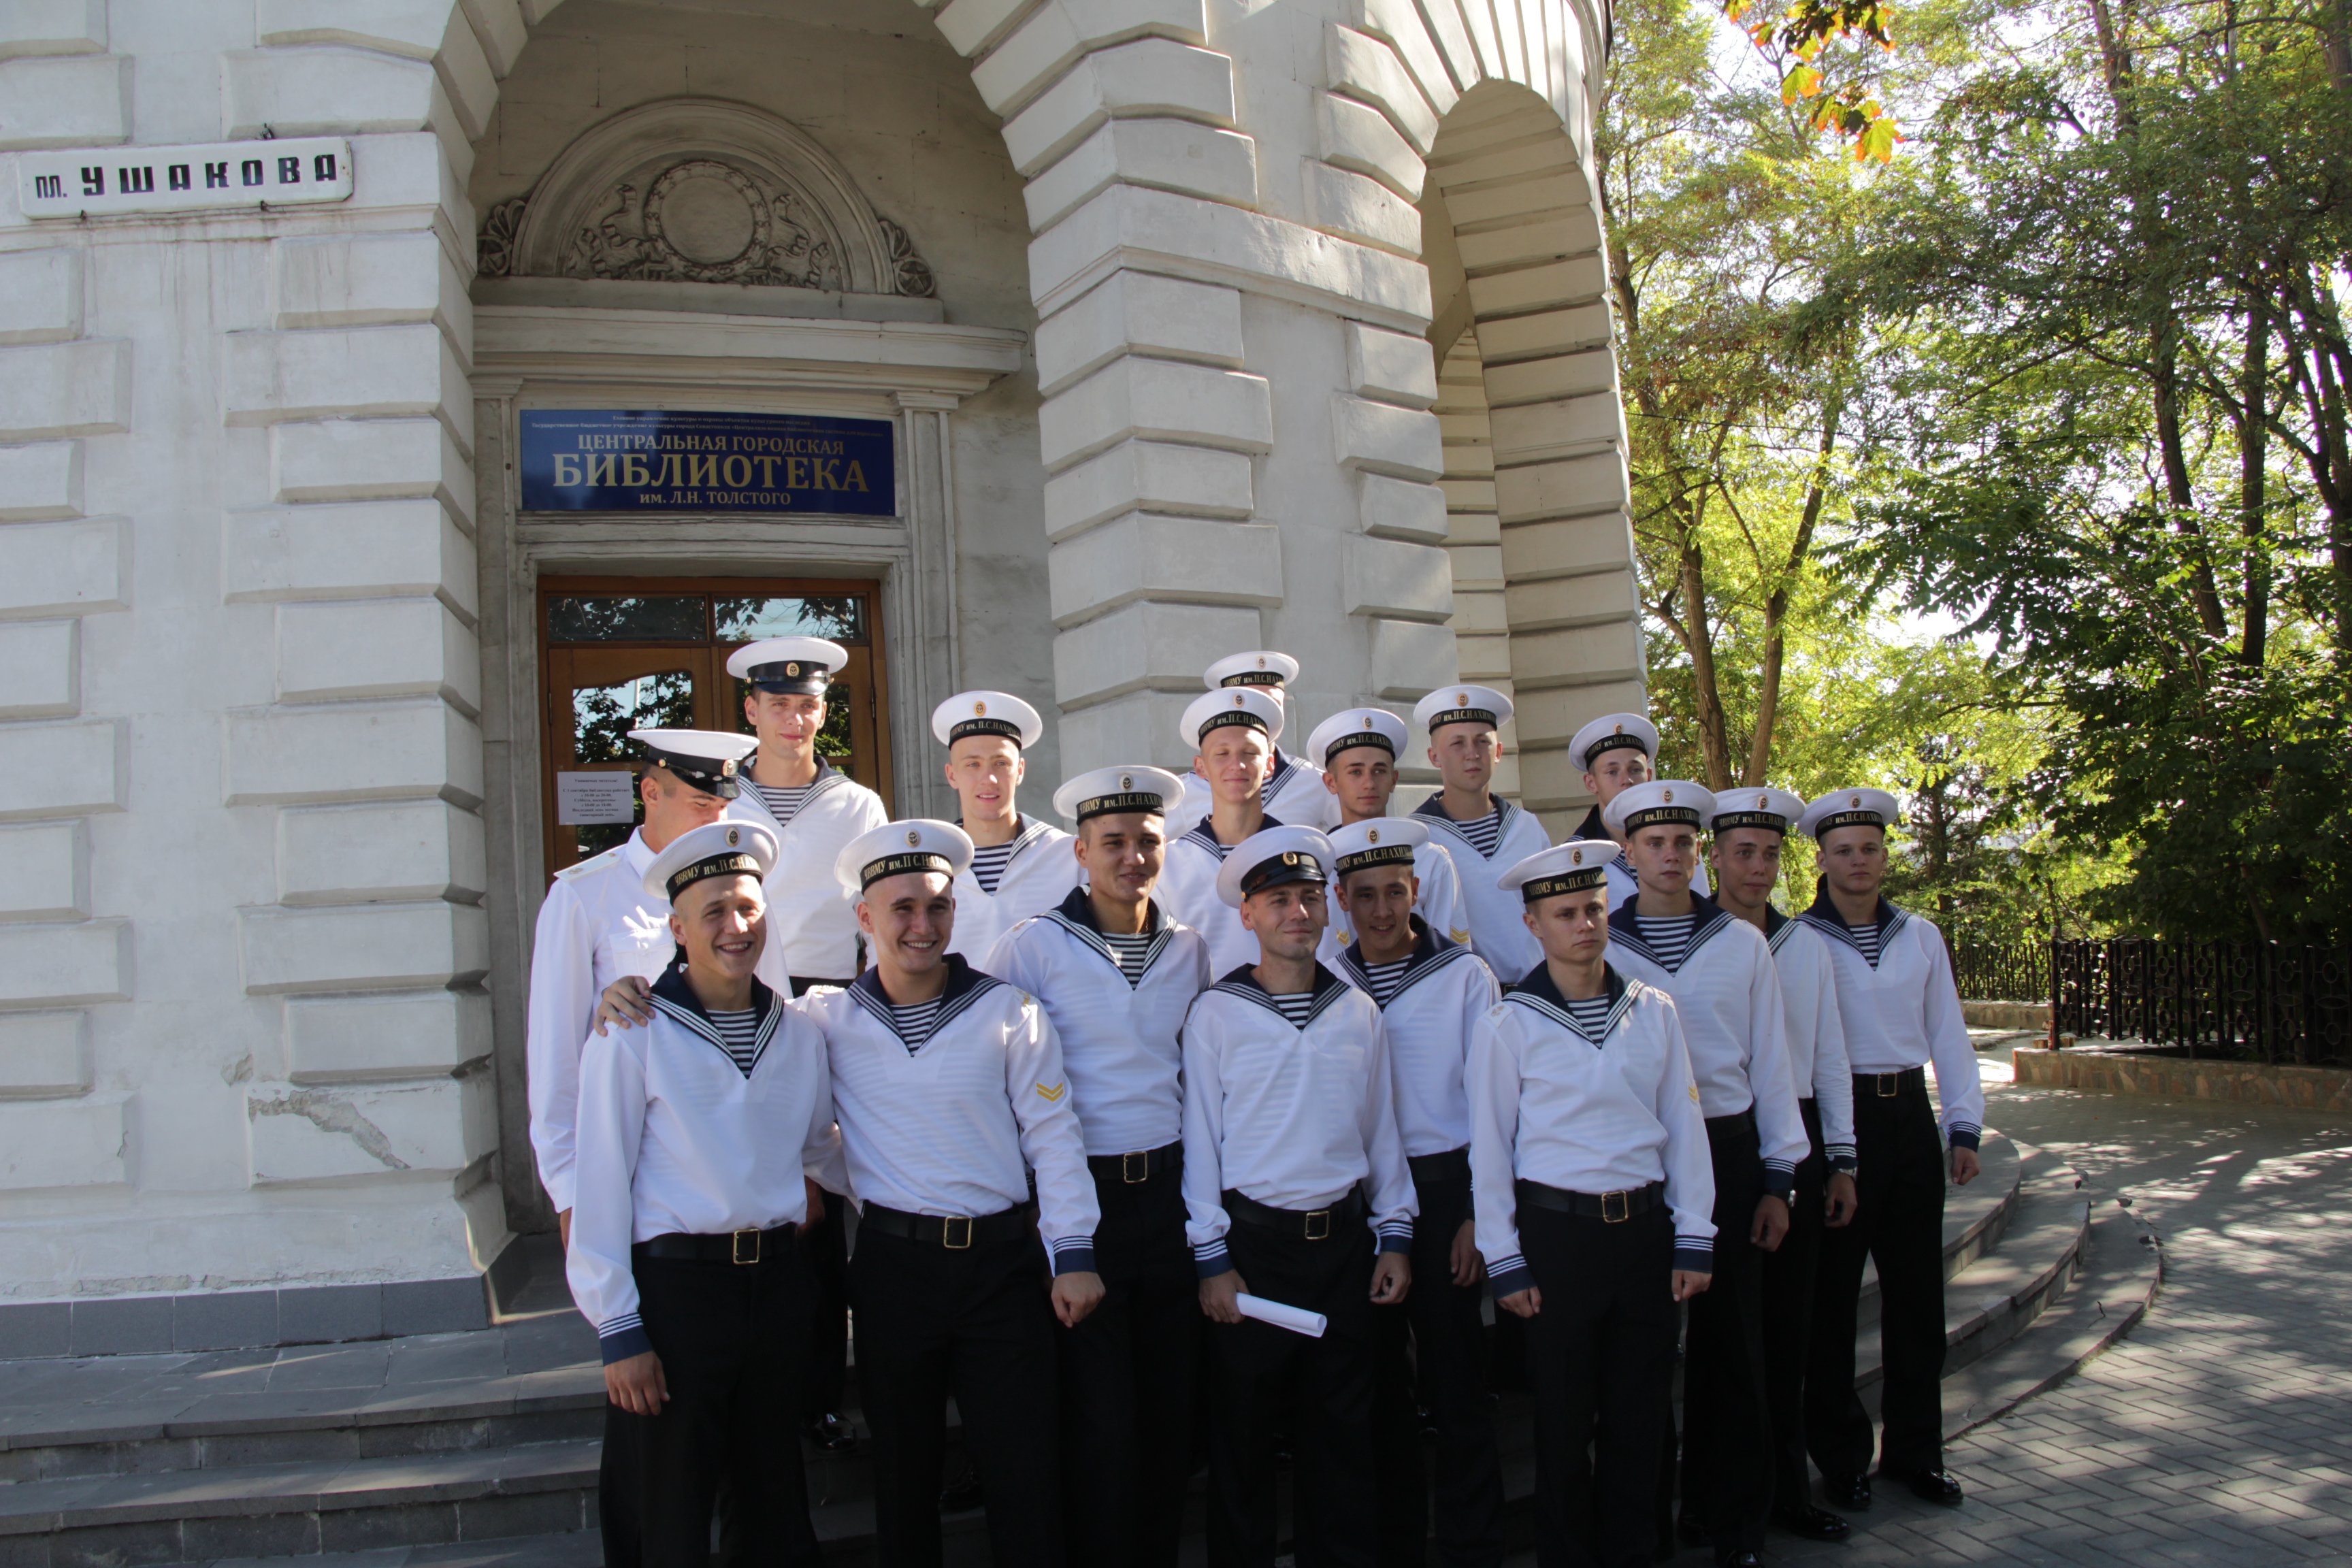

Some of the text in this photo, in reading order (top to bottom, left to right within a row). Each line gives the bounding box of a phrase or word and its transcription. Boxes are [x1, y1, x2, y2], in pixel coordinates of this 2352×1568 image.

[35, 154, 338, 199] пл. УШАКОВА
[578, 434, 844, 455] ЦЕНТРАЛЬНАЯ ГОРОДСКАЯ
[553, 453, 870, 492] БИБЛИОТЕКА
[640, 491, 791, 505] им. Л.Н. ТОЛСТОГО
